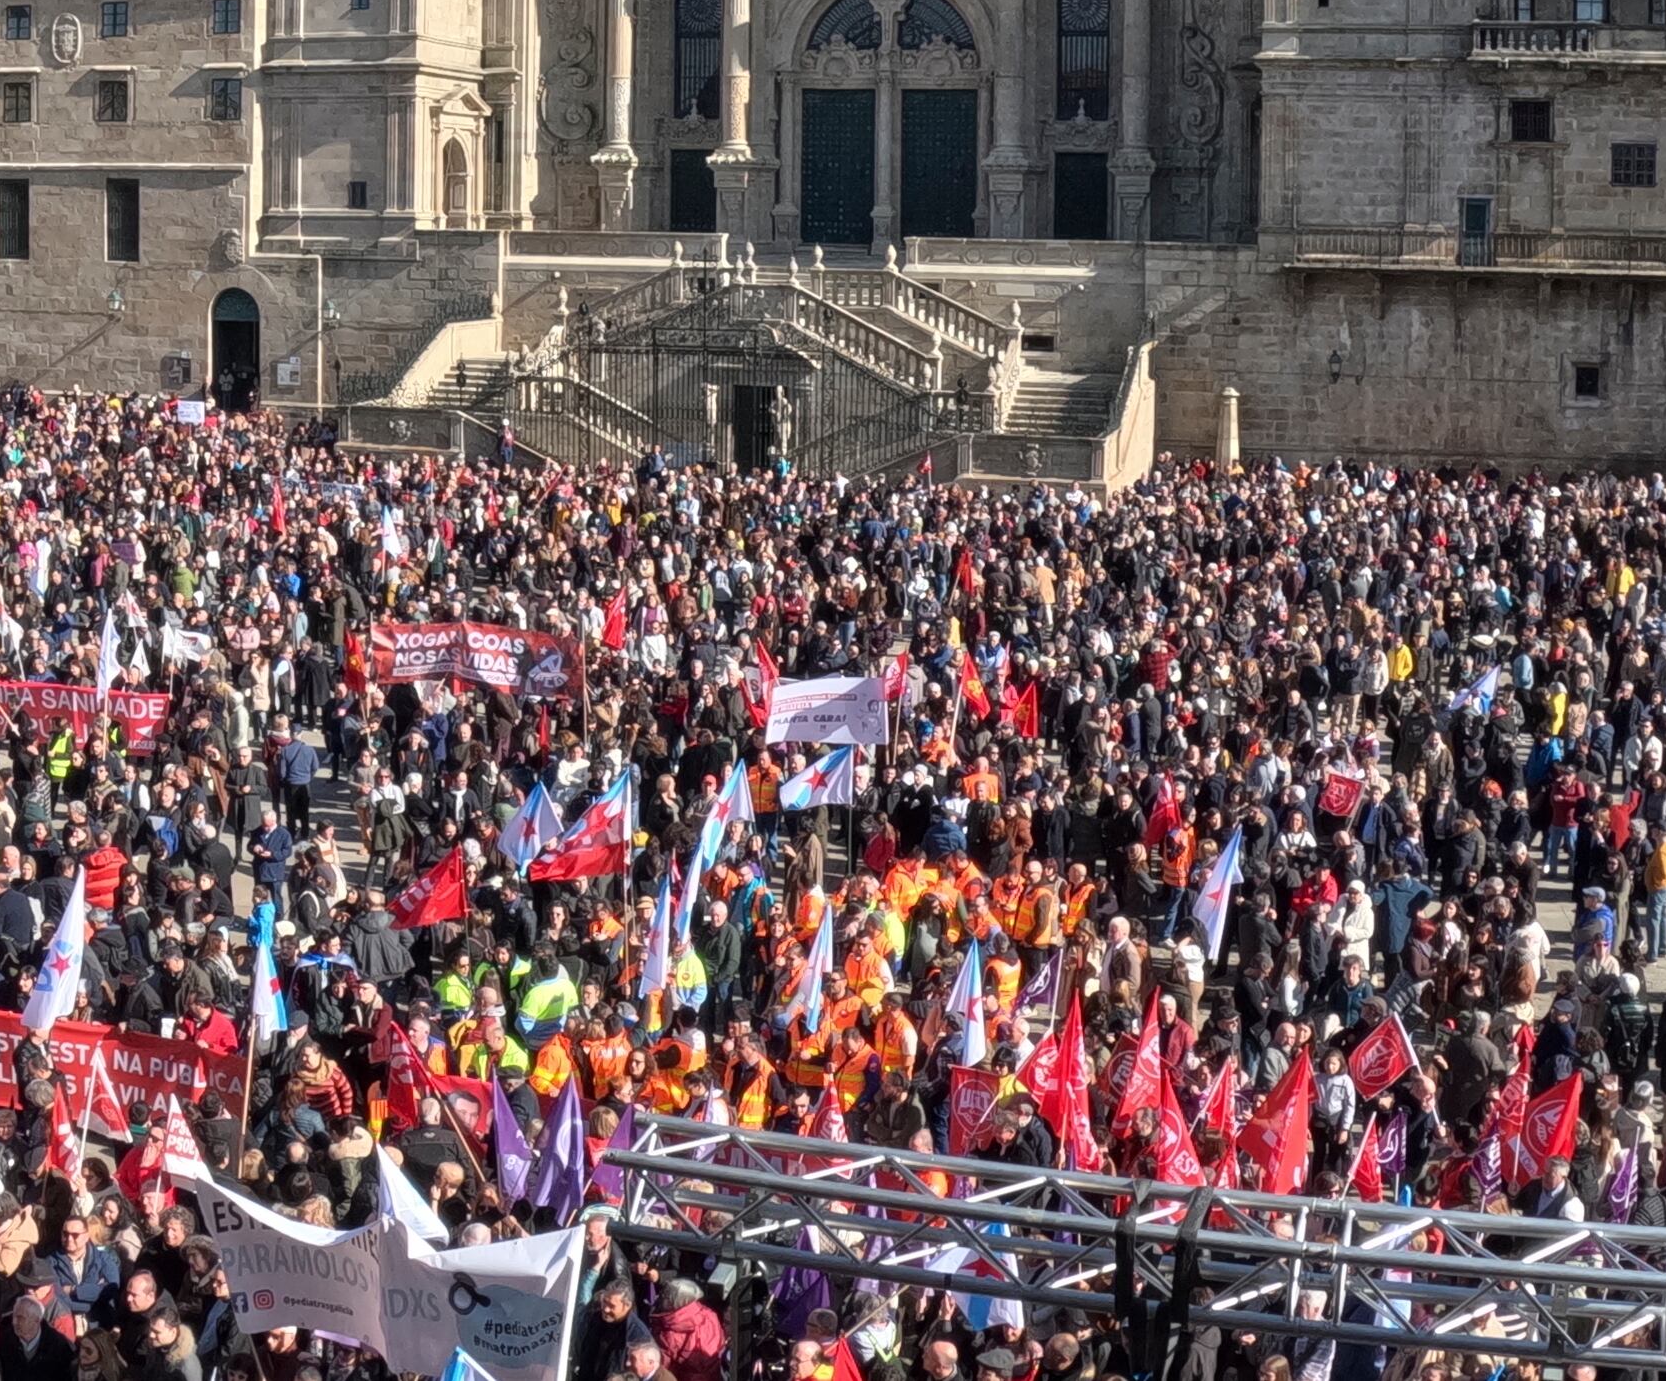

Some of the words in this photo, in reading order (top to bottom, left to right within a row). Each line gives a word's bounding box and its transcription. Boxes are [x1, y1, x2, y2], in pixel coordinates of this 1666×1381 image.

[395, 631, 463, 650] XOGAN
[467, 631, 526, 654] COAS
[395, 648, 462, 667] NOSAS
[463, 652, 520, 675] VIDAS
[113, 1049, 144, 1076] NA
[149, 1054, 244, 1097] PÚBLICA
[220, 1237, 369, 1293] PARÁMOLOS
[282, 1295, 355, 1316] @pediatrasgalicia
